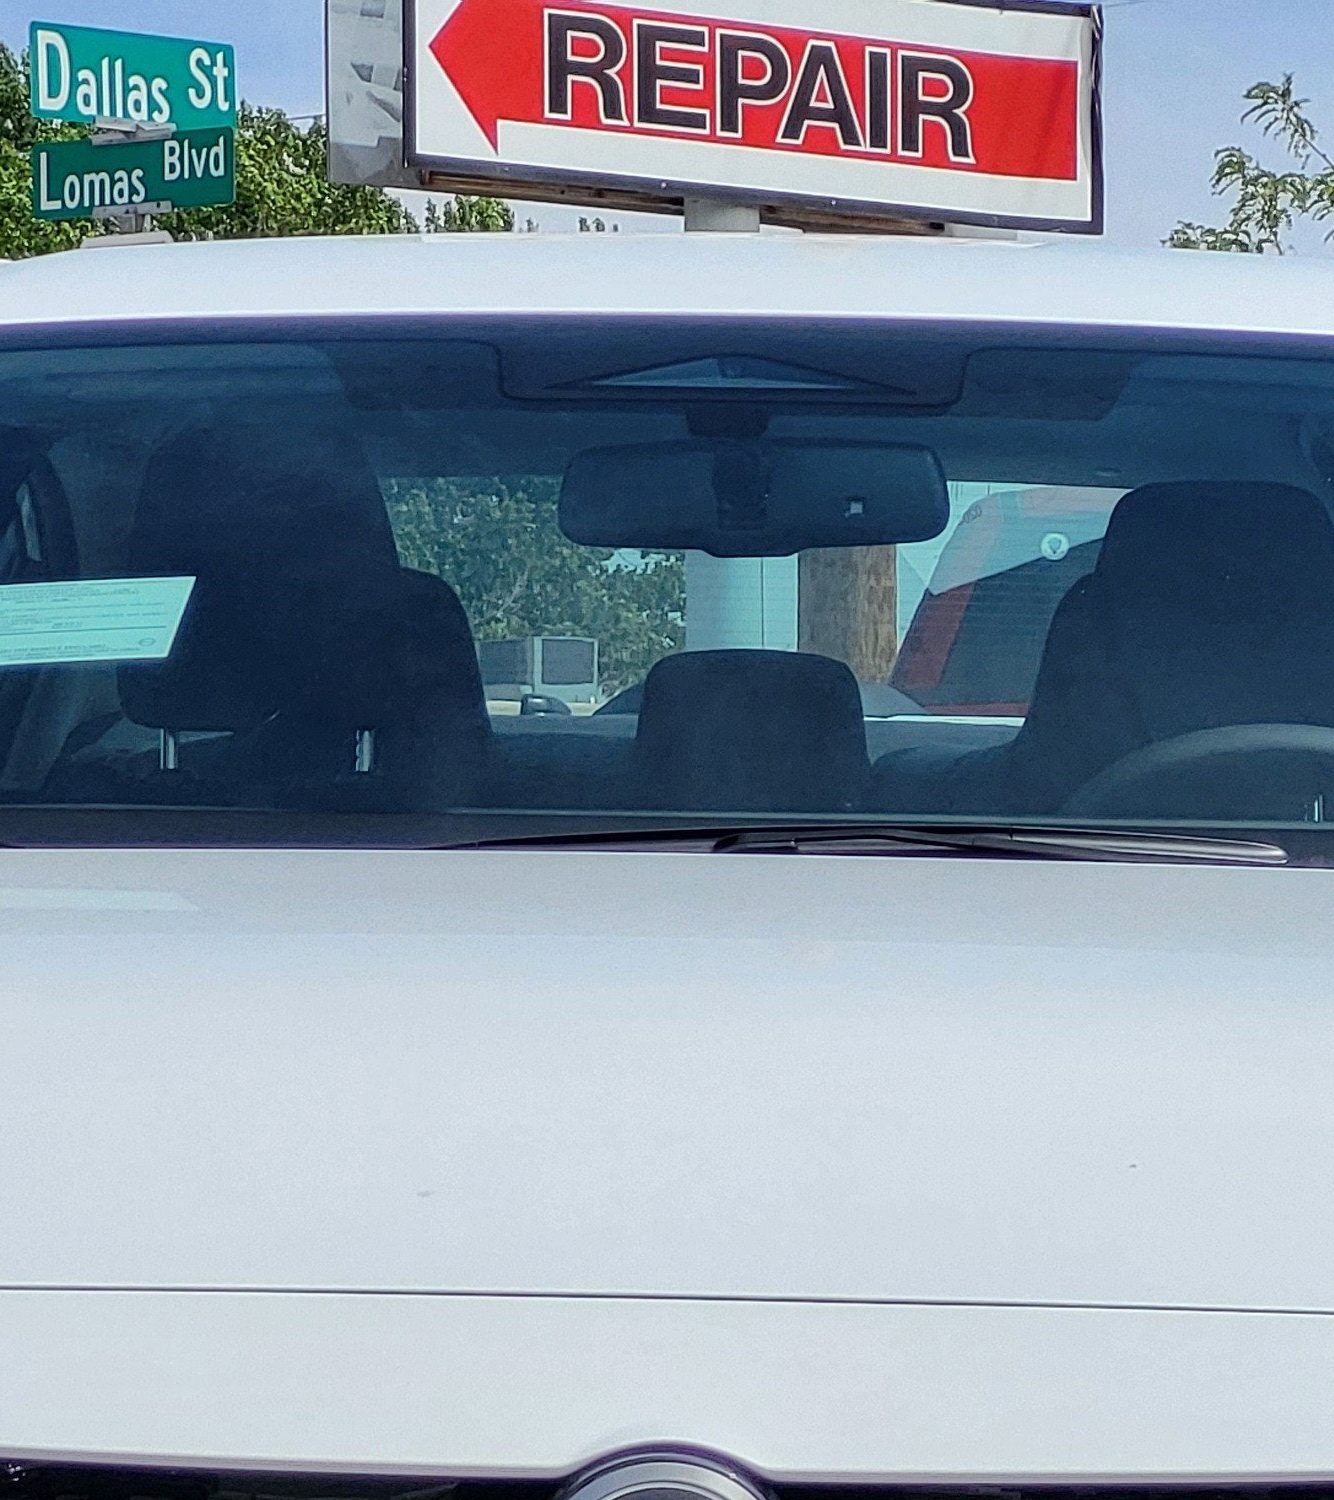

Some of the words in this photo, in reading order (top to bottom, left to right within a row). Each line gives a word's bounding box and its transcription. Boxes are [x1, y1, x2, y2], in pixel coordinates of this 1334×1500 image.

[37, 30, 170, 122] Dallas
[188, 48, 229, 111] St
[544, 10, 974, 163] REPAIR
[40, 152, 145, 210] Lomas
[163, 135, 224, 180] Blvd
